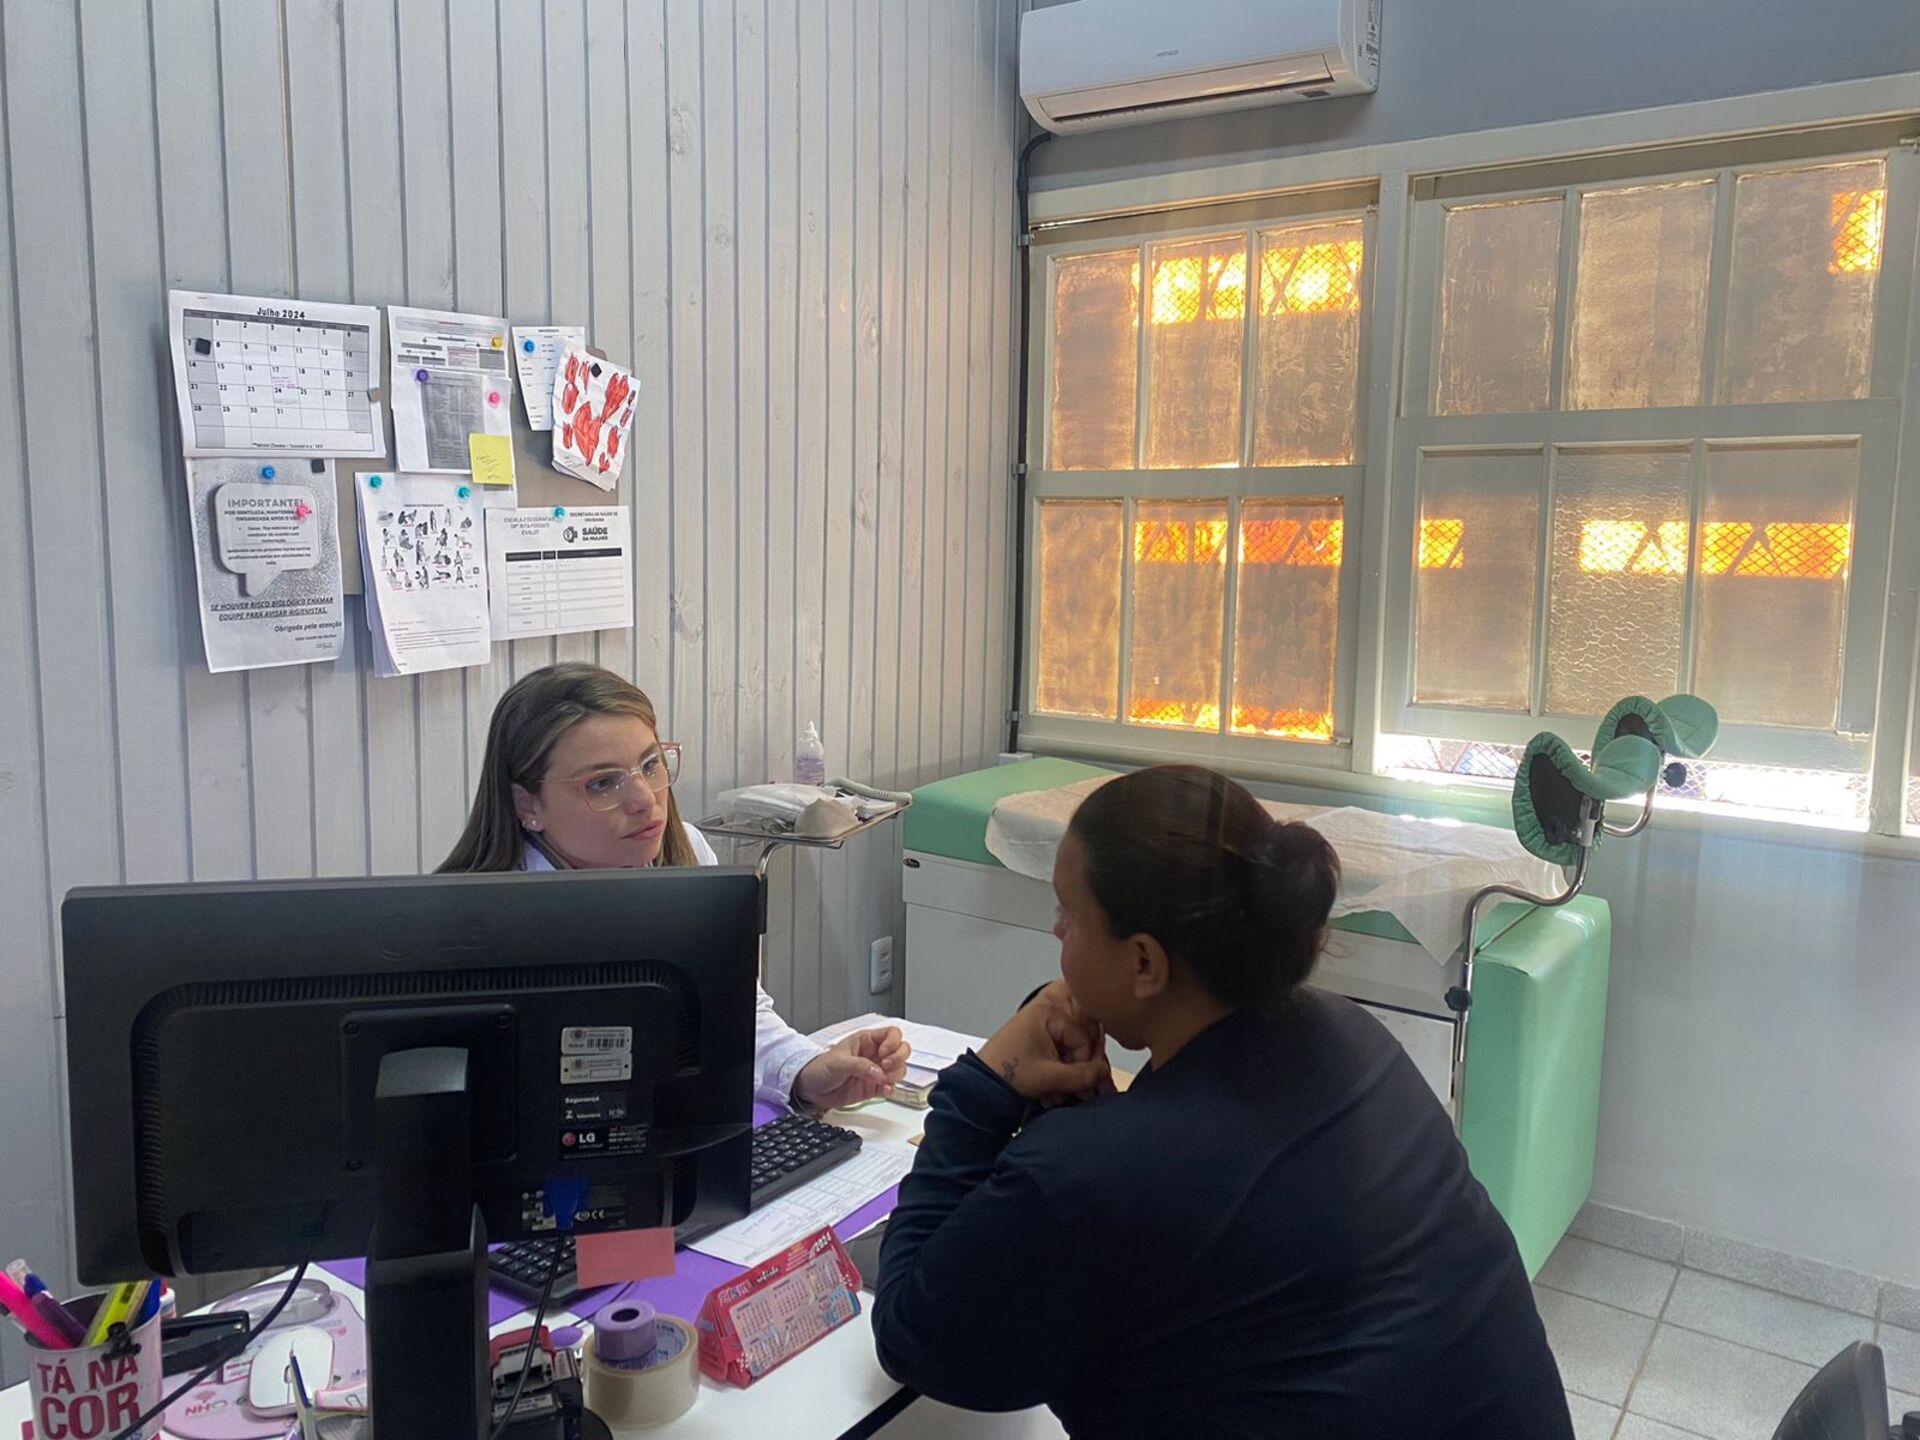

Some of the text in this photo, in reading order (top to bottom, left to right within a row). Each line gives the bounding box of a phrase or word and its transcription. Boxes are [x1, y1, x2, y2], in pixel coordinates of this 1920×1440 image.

[257, 307, 279, 317] Julho
[282, 309, 305, 318] 2024
[228, 498, 303, 508] IMPORTANTE!
[582, 526, 608, 535] SAÚDE
[220, 602, 250, 611] HOUVER
[250, 600, 270, 609] RISCO
[271, 598, 306, 608] BIOLÓGICO
[307, 597, 333, 606] CHAMAR
[218, 612, 244, 621] EQUIPE
[246, 611, 263, 620] PARA
[265, 609, 287, 618] AVISAR
[579, 1132, 596, 1144] LG
[814, 1232, 832, 1252] 2024
[36, 1354, 138, 1394] TÁ NA
[40, 1382, 140, 1440] COR
